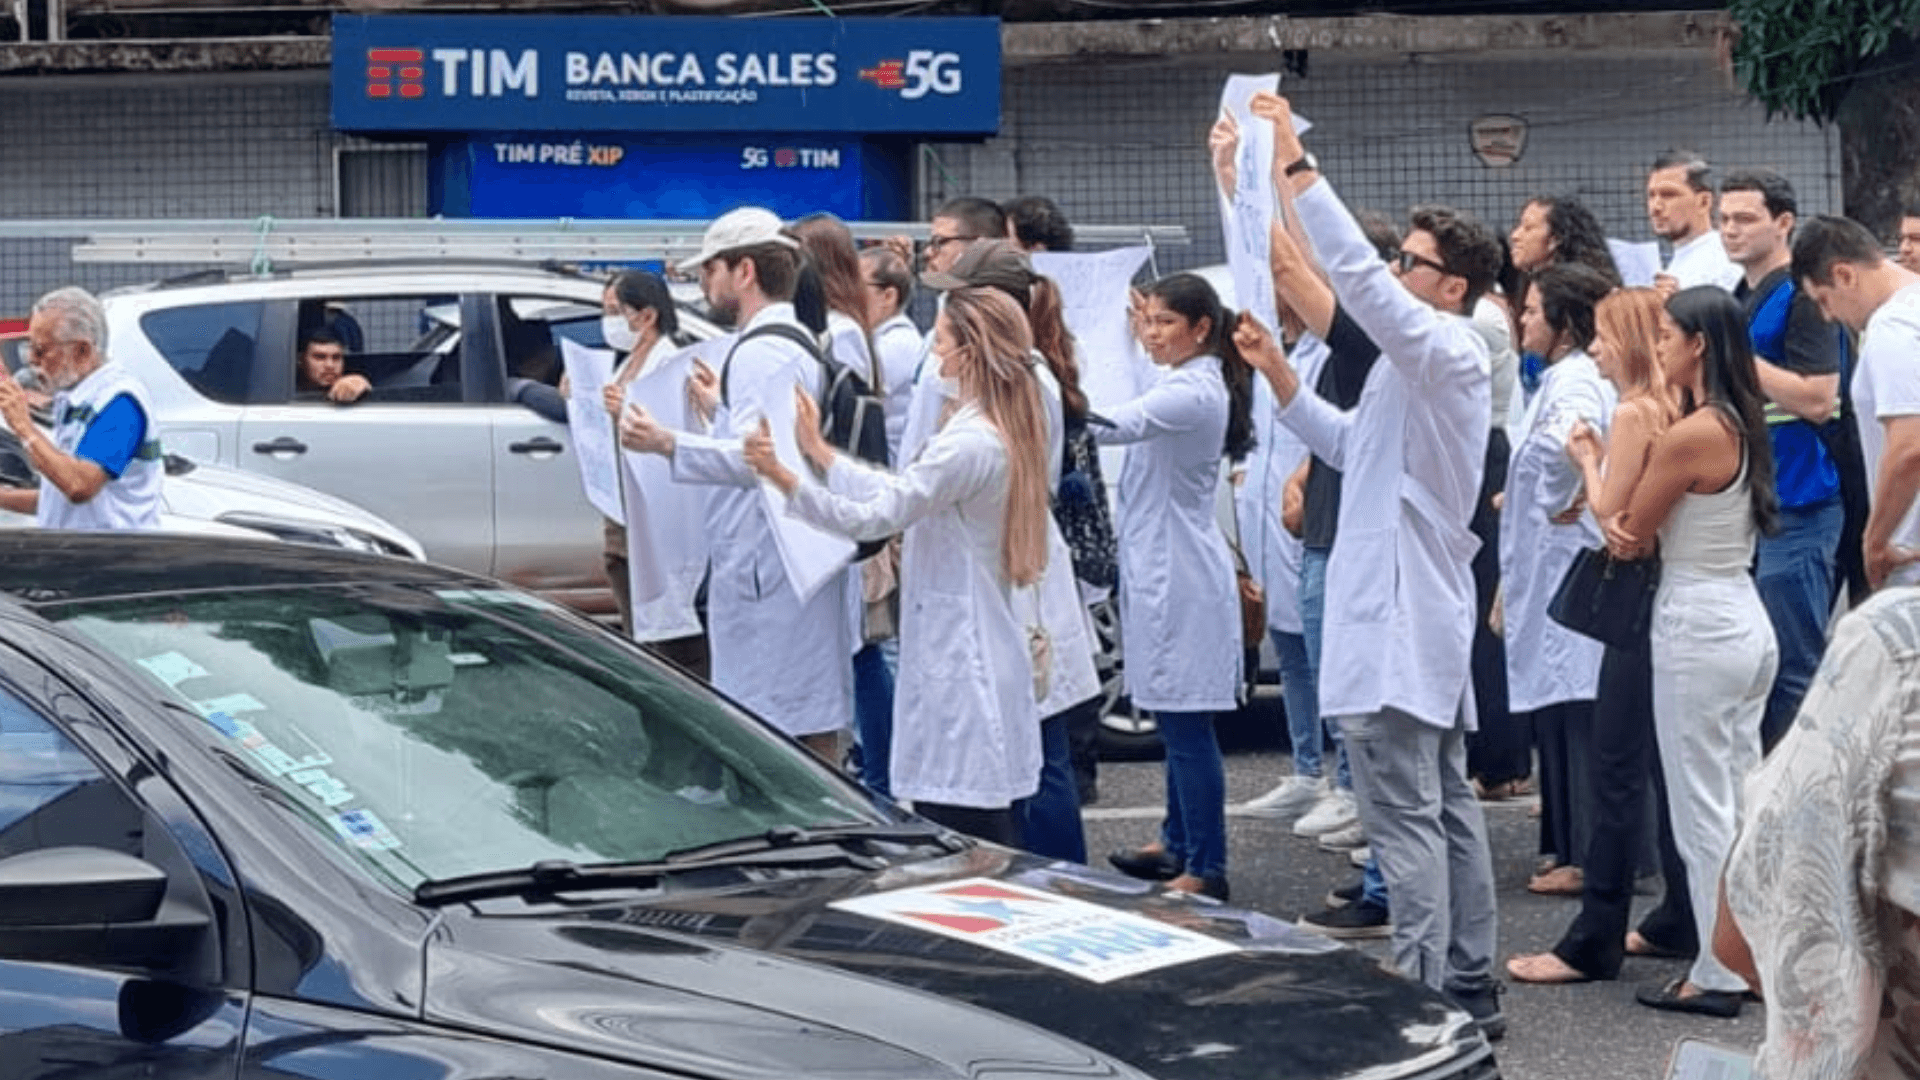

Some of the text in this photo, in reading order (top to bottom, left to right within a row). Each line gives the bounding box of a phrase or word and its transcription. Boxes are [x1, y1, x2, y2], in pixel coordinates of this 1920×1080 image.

[433, 48, 538, 97] TIM
[566, 52, 837, 86] BANCA SALES
[900, 50, 962, 99] 5G
[494, 139, 624, 166] TIM PRÉ XIP
[741, 147, 840, 169] 5G TIM
